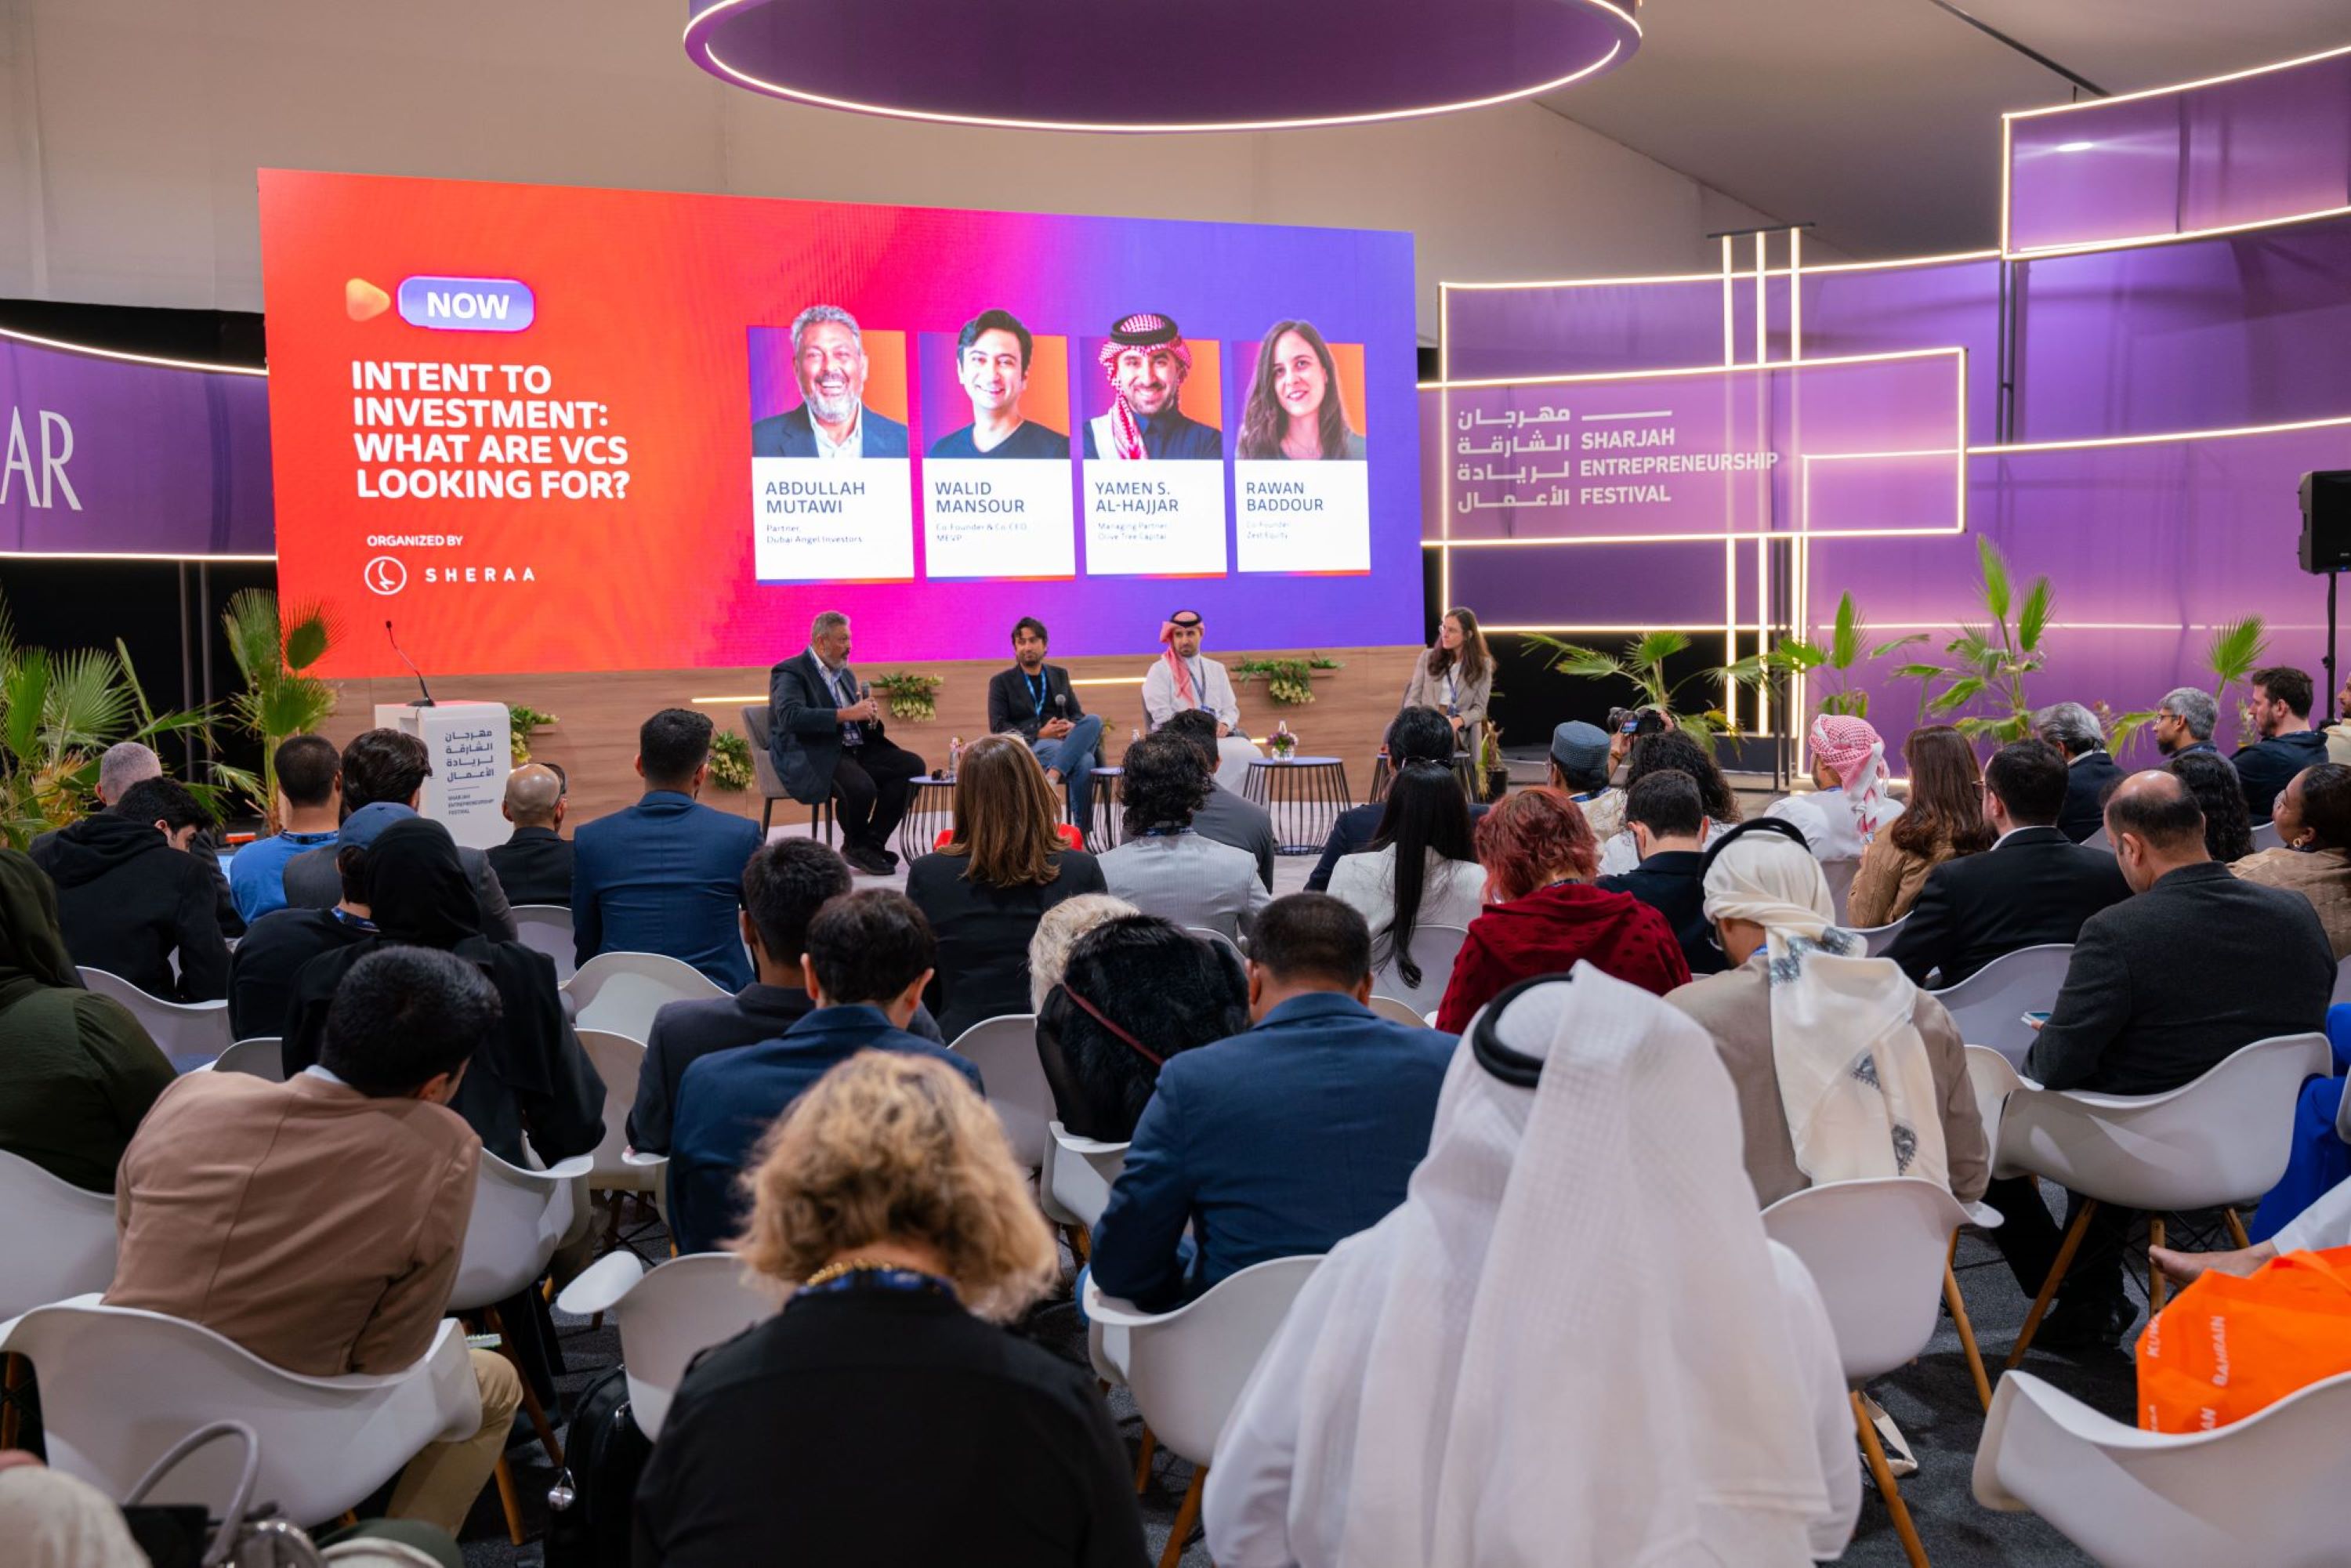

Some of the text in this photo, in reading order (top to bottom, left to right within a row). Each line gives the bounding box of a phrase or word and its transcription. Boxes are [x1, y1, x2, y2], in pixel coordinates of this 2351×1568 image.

[427, 292, 509, 320] NOW
[352, 360, 552, 394] INTENT TO
[353, 397, 608, 429] INVESTMENT:
[1458, 406, 1571, 430] مهرجان
[353, 433, 629, 465] WHAT ARE VCS
[1457, 429, 1570, 458] الشارقة
[1581, 428, 1675, 450] SHARJAH
[1457, 460, 1570, 483] لريادة
[1580, 451, 1779, 476] ENTREPRENEURSHIP
[357, 468, 631, 499] LOOKING FOR?
[765, 481, 865, 496] ABDULLAH
[935, 481, 991, 495] WALID
[1095, 481, 1170, 496] YAMEN S.
[1246, 481, 1304, 495] RAWAN
[1457, 485, 1570, 513] الأعمال
[1580, 483, 1672, 505] FESTIVAL
[766, 499, 842, 514] MUTAWI
[936, 498, 1024, 513] MANSOUR
[1096, 498, 1179, 516] AL-HAJJAR
[1246, 498, 1324, 512] BADDOUR
[366, 534, 463, 547] ORGANIZED BY
[795, 535, 820, 545] Angel
[821, 535, 863, 544] Investors
[426, 567, 535, 582] SHERAA
[444, 729, 493, 743] مهرجان
[445, 741, 493, 755] الشارقة
[2210, 1316, 2230, 1386] BAHRAIN
